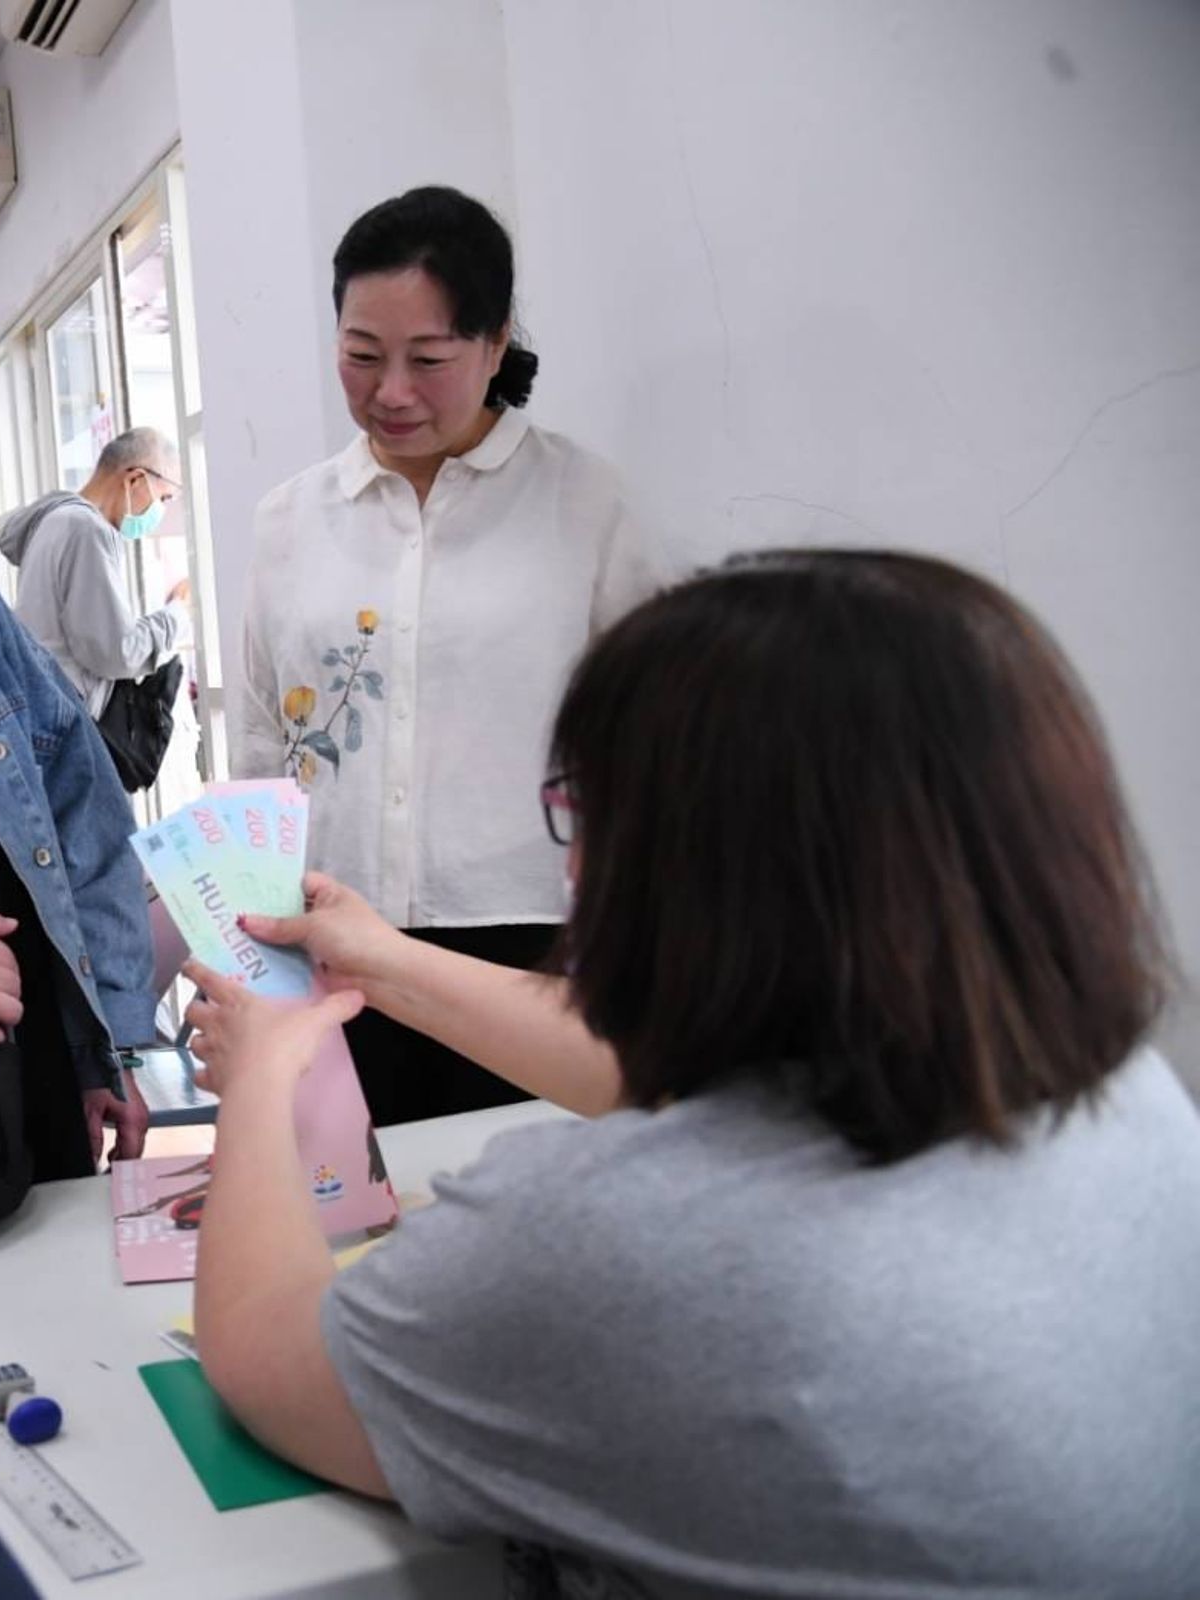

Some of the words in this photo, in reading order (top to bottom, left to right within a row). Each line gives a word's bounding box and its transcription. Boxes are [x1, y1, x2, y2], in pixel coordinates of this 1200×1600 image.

[191, 807, 224, 844] 200
[245, 808, 268, 848] 200
[279, 814, 297, 856] 200
[192, 872, 269, 981] HUALIEN
